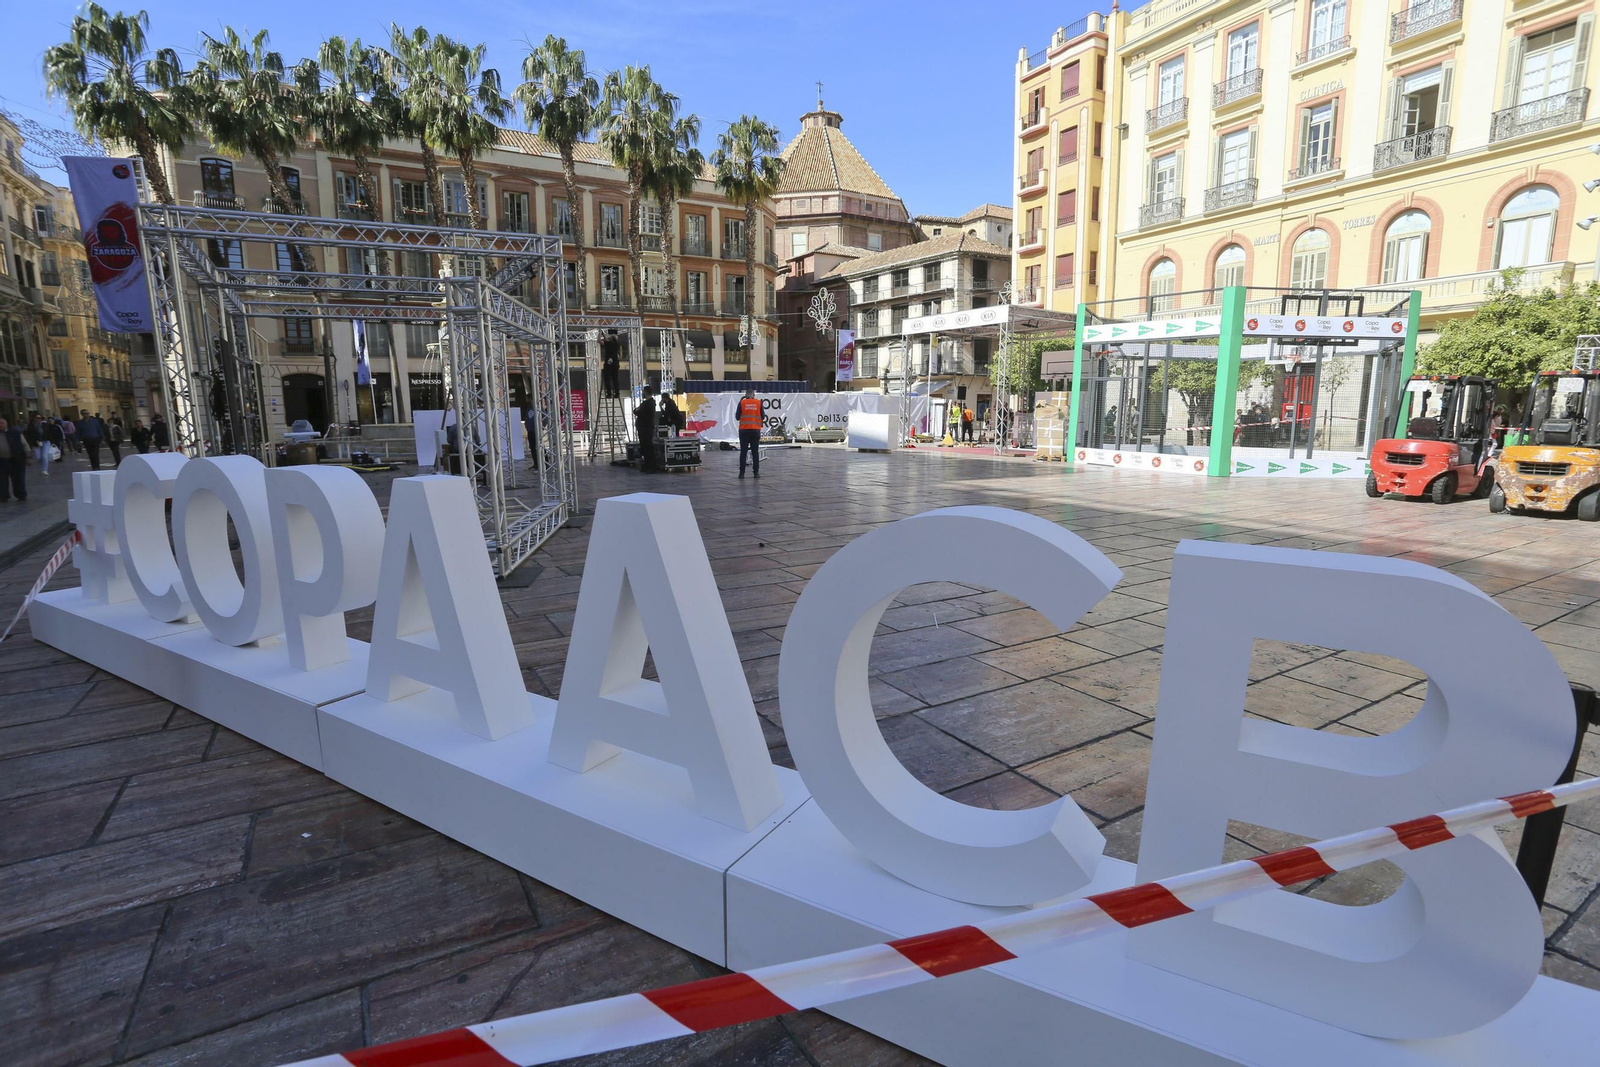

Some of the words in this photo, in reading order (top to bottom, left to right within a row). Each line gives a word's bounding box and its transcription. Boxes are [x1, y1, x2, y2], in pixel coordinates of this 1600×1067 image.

[1300, 78, 1344, 101] CLINICA
[1253, 233, 1280, 246] MARTI
[1342, 215, 1376, 230] TORRES
[116, 311, 138, 319] Copa
[818, 414, 832, 423] Del
[832, 414, 841, 423] 13
